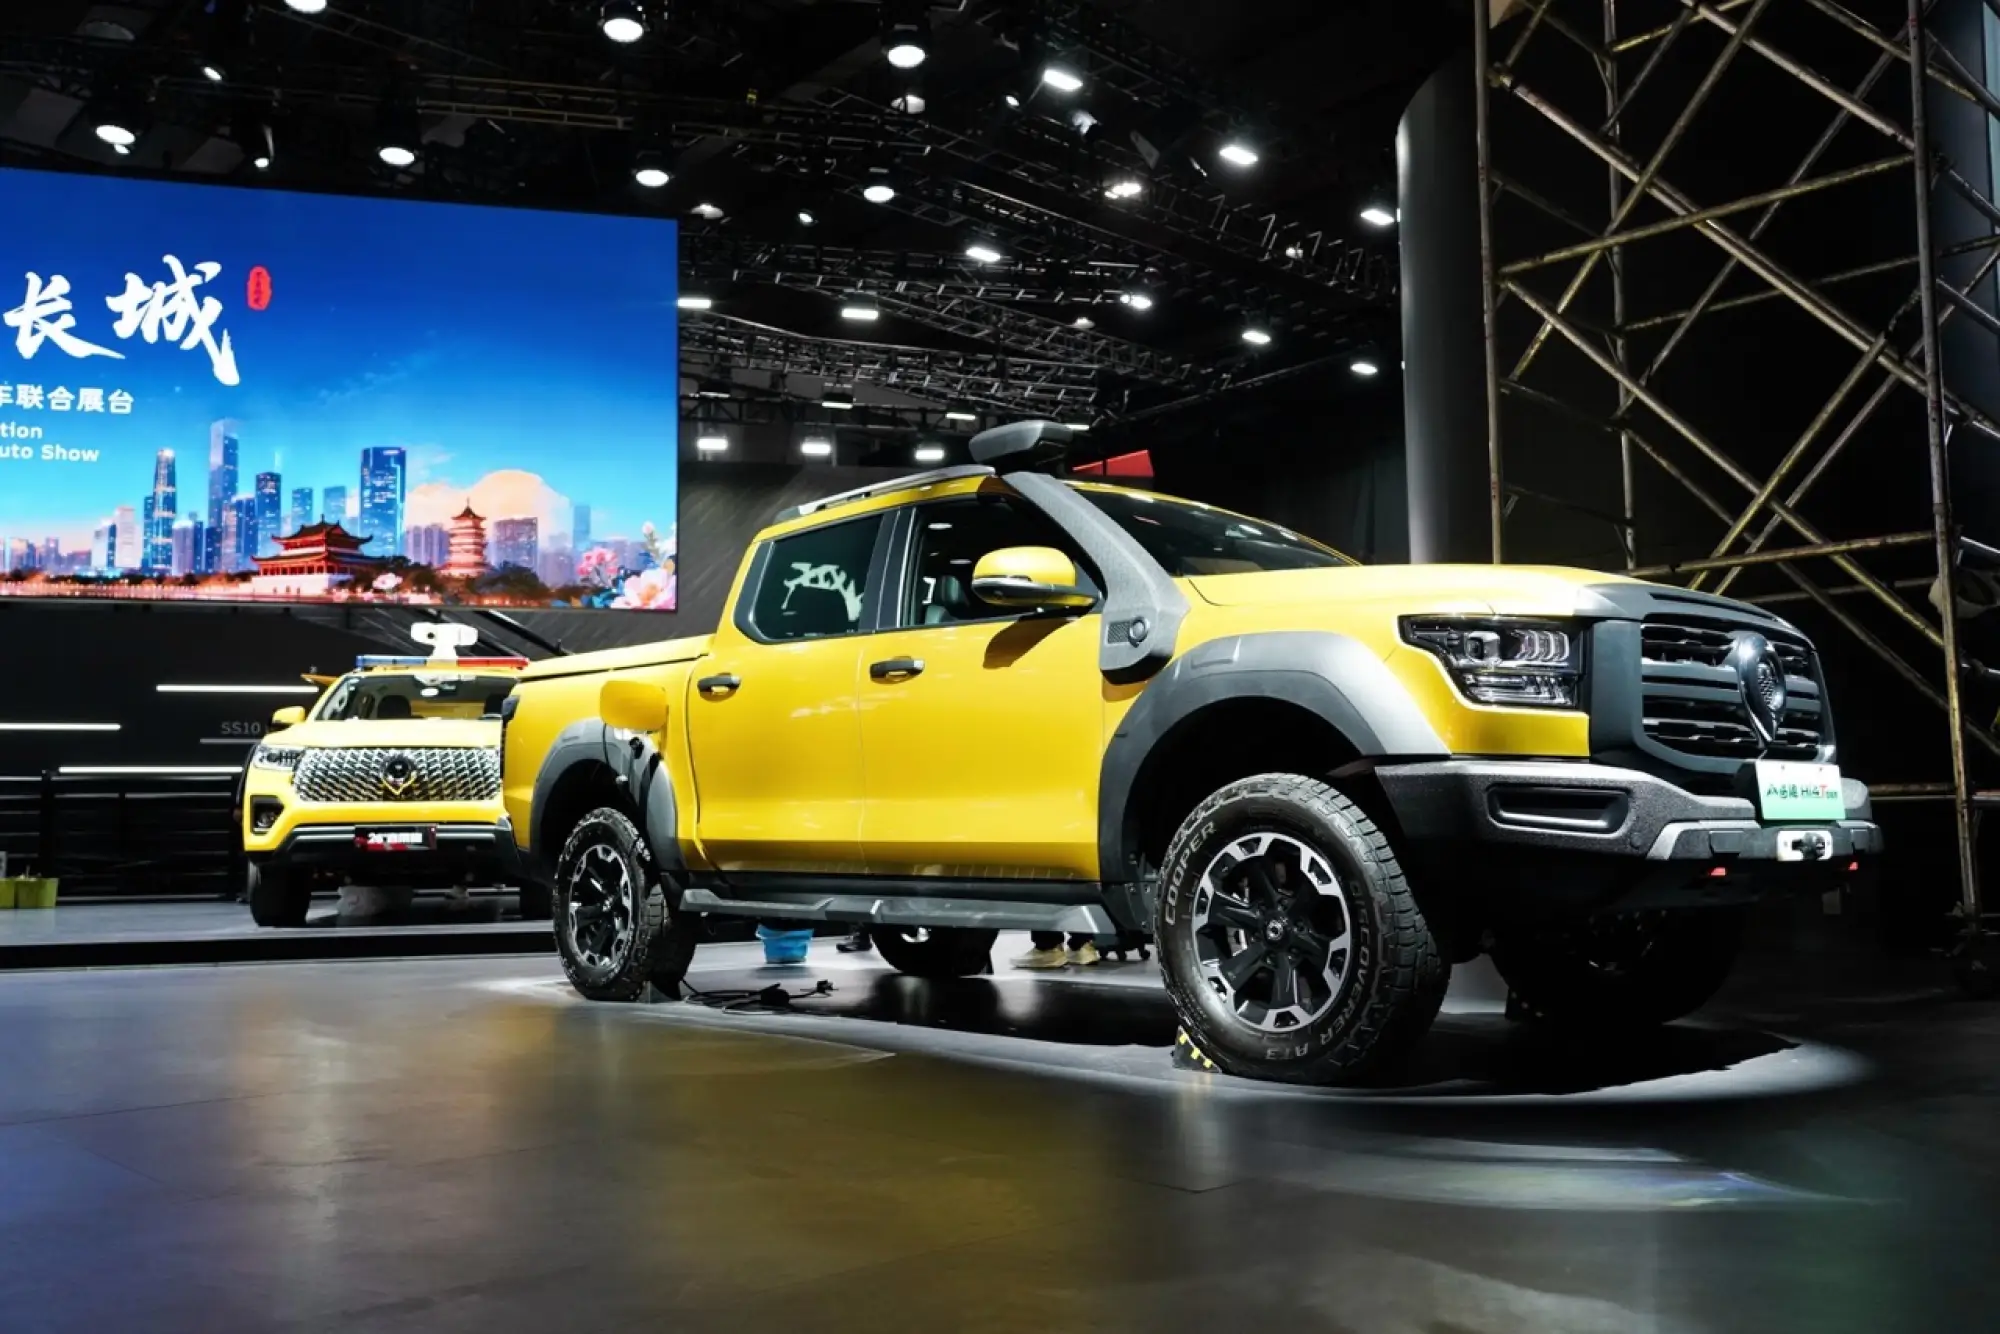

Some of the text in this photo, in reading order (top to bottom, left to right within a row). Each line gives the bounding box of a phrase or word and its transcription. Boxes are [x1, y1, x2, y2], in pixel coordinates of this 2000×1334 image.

[2, 254, 240, 386] 长城
[0, 421, 43, 439] tion
[41, 443, 100, 462] Show
[221, 721, 261, 735] SS10
[1165, 821, 1216, 926] COOPER
